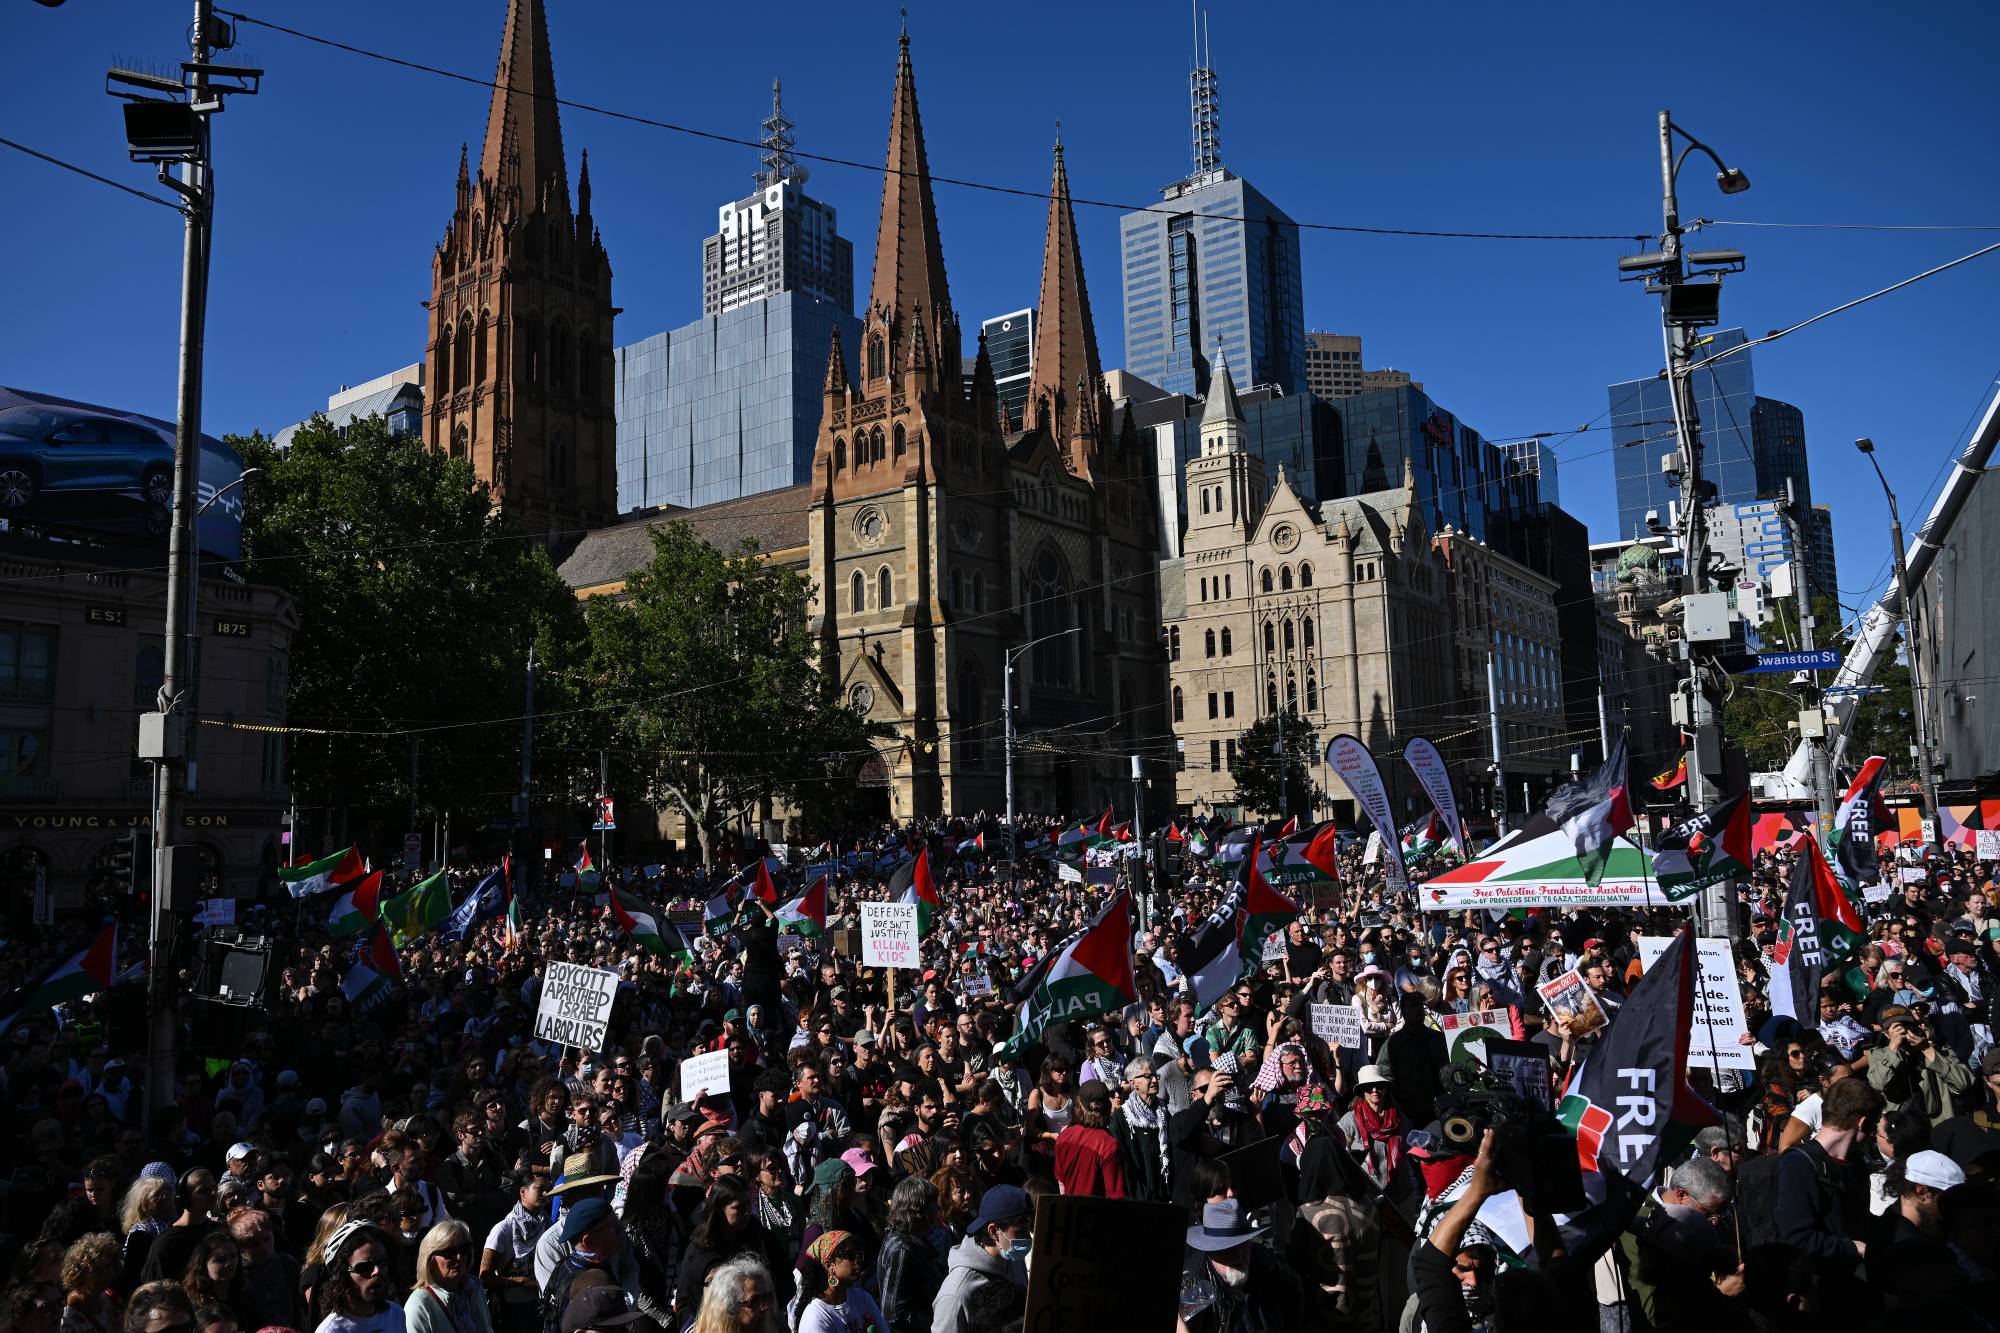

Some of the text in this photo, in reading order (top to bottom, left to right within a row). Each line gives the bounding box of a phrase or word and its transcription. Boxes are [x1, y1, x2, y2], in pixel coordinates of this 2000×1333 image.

[217, 622, 249, 635] 1875
[1759, 650, 1836, 667] Swanston St
[14, 815, 227, 828] YOUNG & JASON
[1851, 799, 1869, 843] FREE
[1473, 885, 1643, 898] Free Palestine Fundraiser Australia
[873, 920, 911, 929] DOESN'T
[870, 929, 909, 940] JUSTIFY
[1794, 902, 1821, 967] FREE
[873, 940, 910, 951] KILLING
[878, 951, 905, 963] KIDS
[548, 961, 611, 991] BOYCOTT
[544, 981, 610, 1007] APARTHEID
[1311, 1006, 1357, 1017] ENOCIDE INCITERS
[1707, 1004, 1730, 1013] ties
[1328, 1016, 1346, 1025] BEHIND
[1346, 1017, 1360, 1027] BARS
[1326, 1025, 1341, 1034] HAGUE
[1341, 1027, 1352, 1035] NOT
[1351, 1028, 1360, 1036] ON
[1340, 1036, 1360, 1047] SYDNEY
[1707, 1050, 1741, 1058] Women
